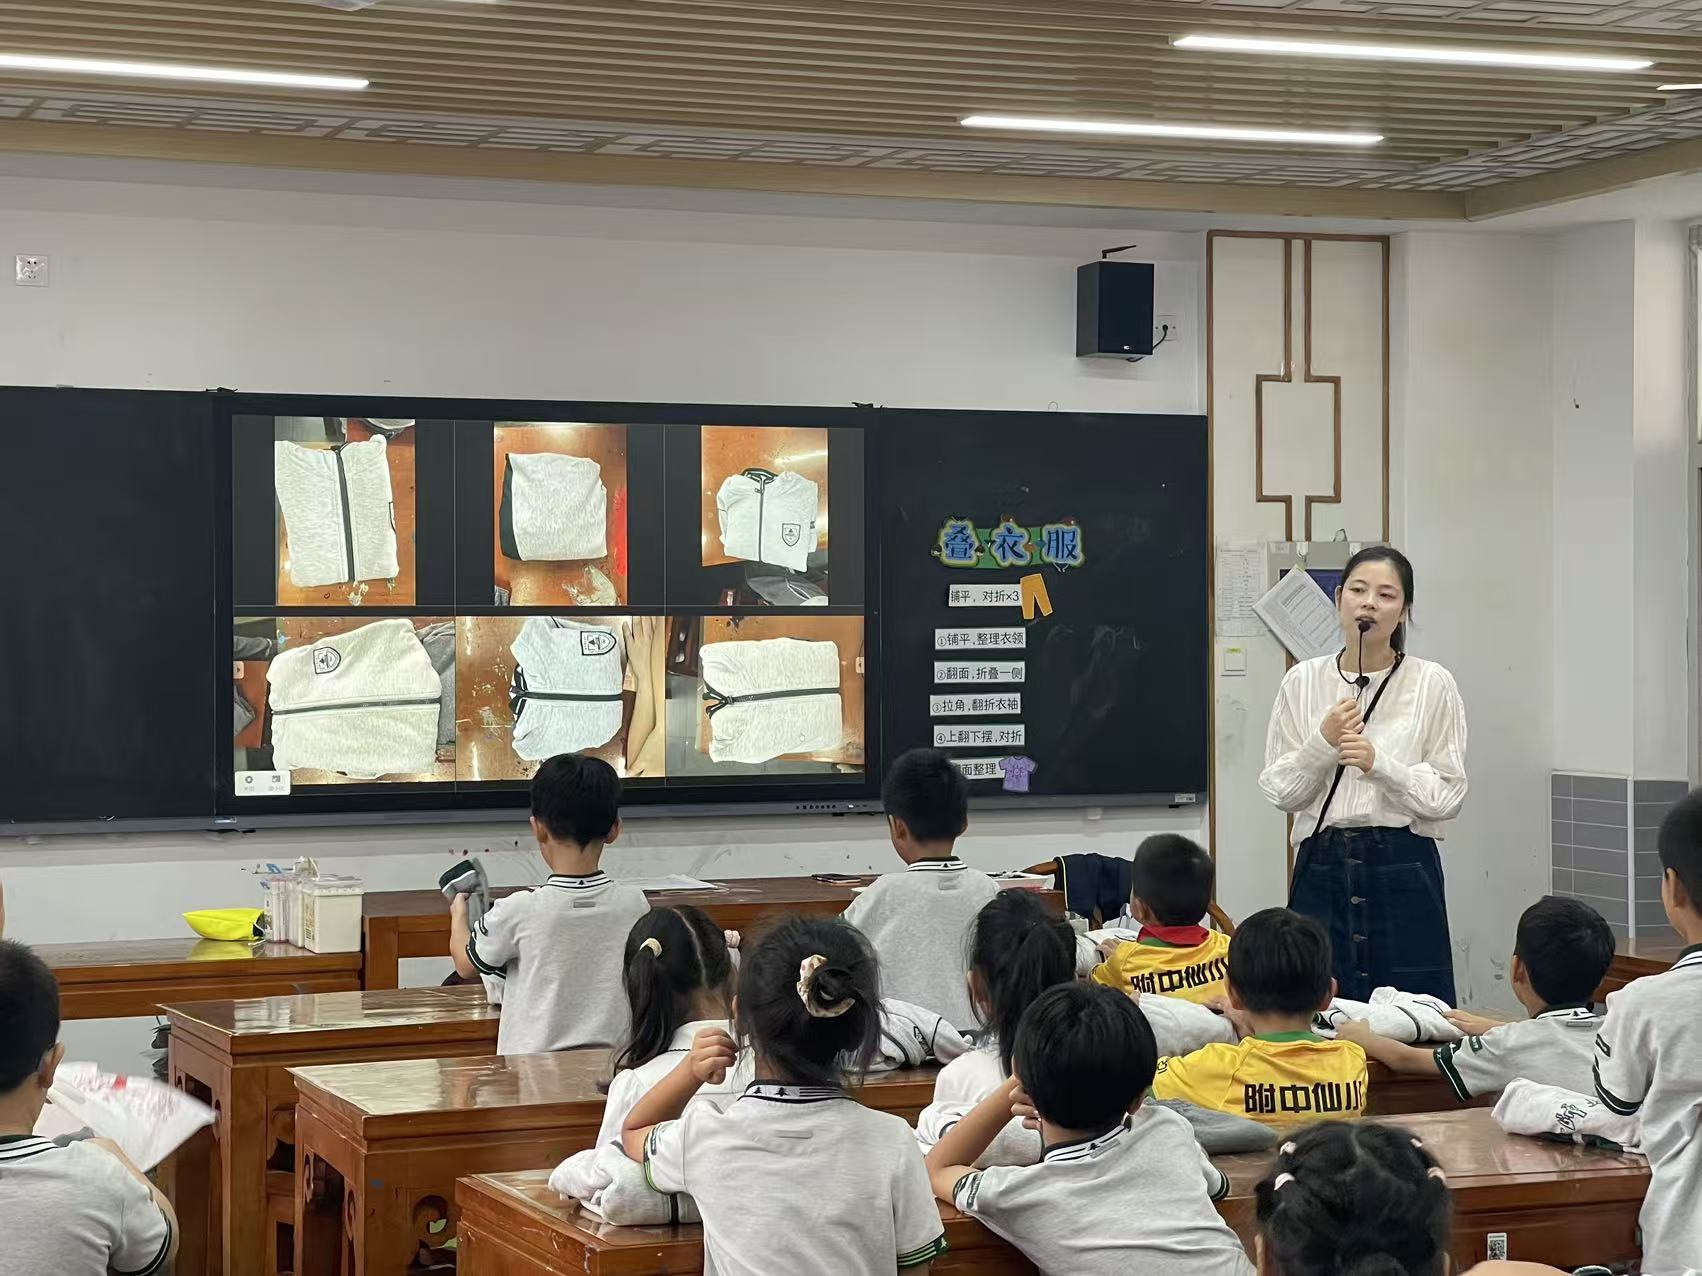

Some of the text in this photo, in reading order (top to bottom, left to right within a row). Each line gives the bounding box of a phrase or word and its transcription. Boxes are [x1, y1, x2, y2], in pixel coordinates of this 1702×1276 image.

[943, 525, 1078, 561] 叠衣服
[957, 762, 997, 776] 面整理
[1244, 1081, 1362, 1113] 附中仙小
